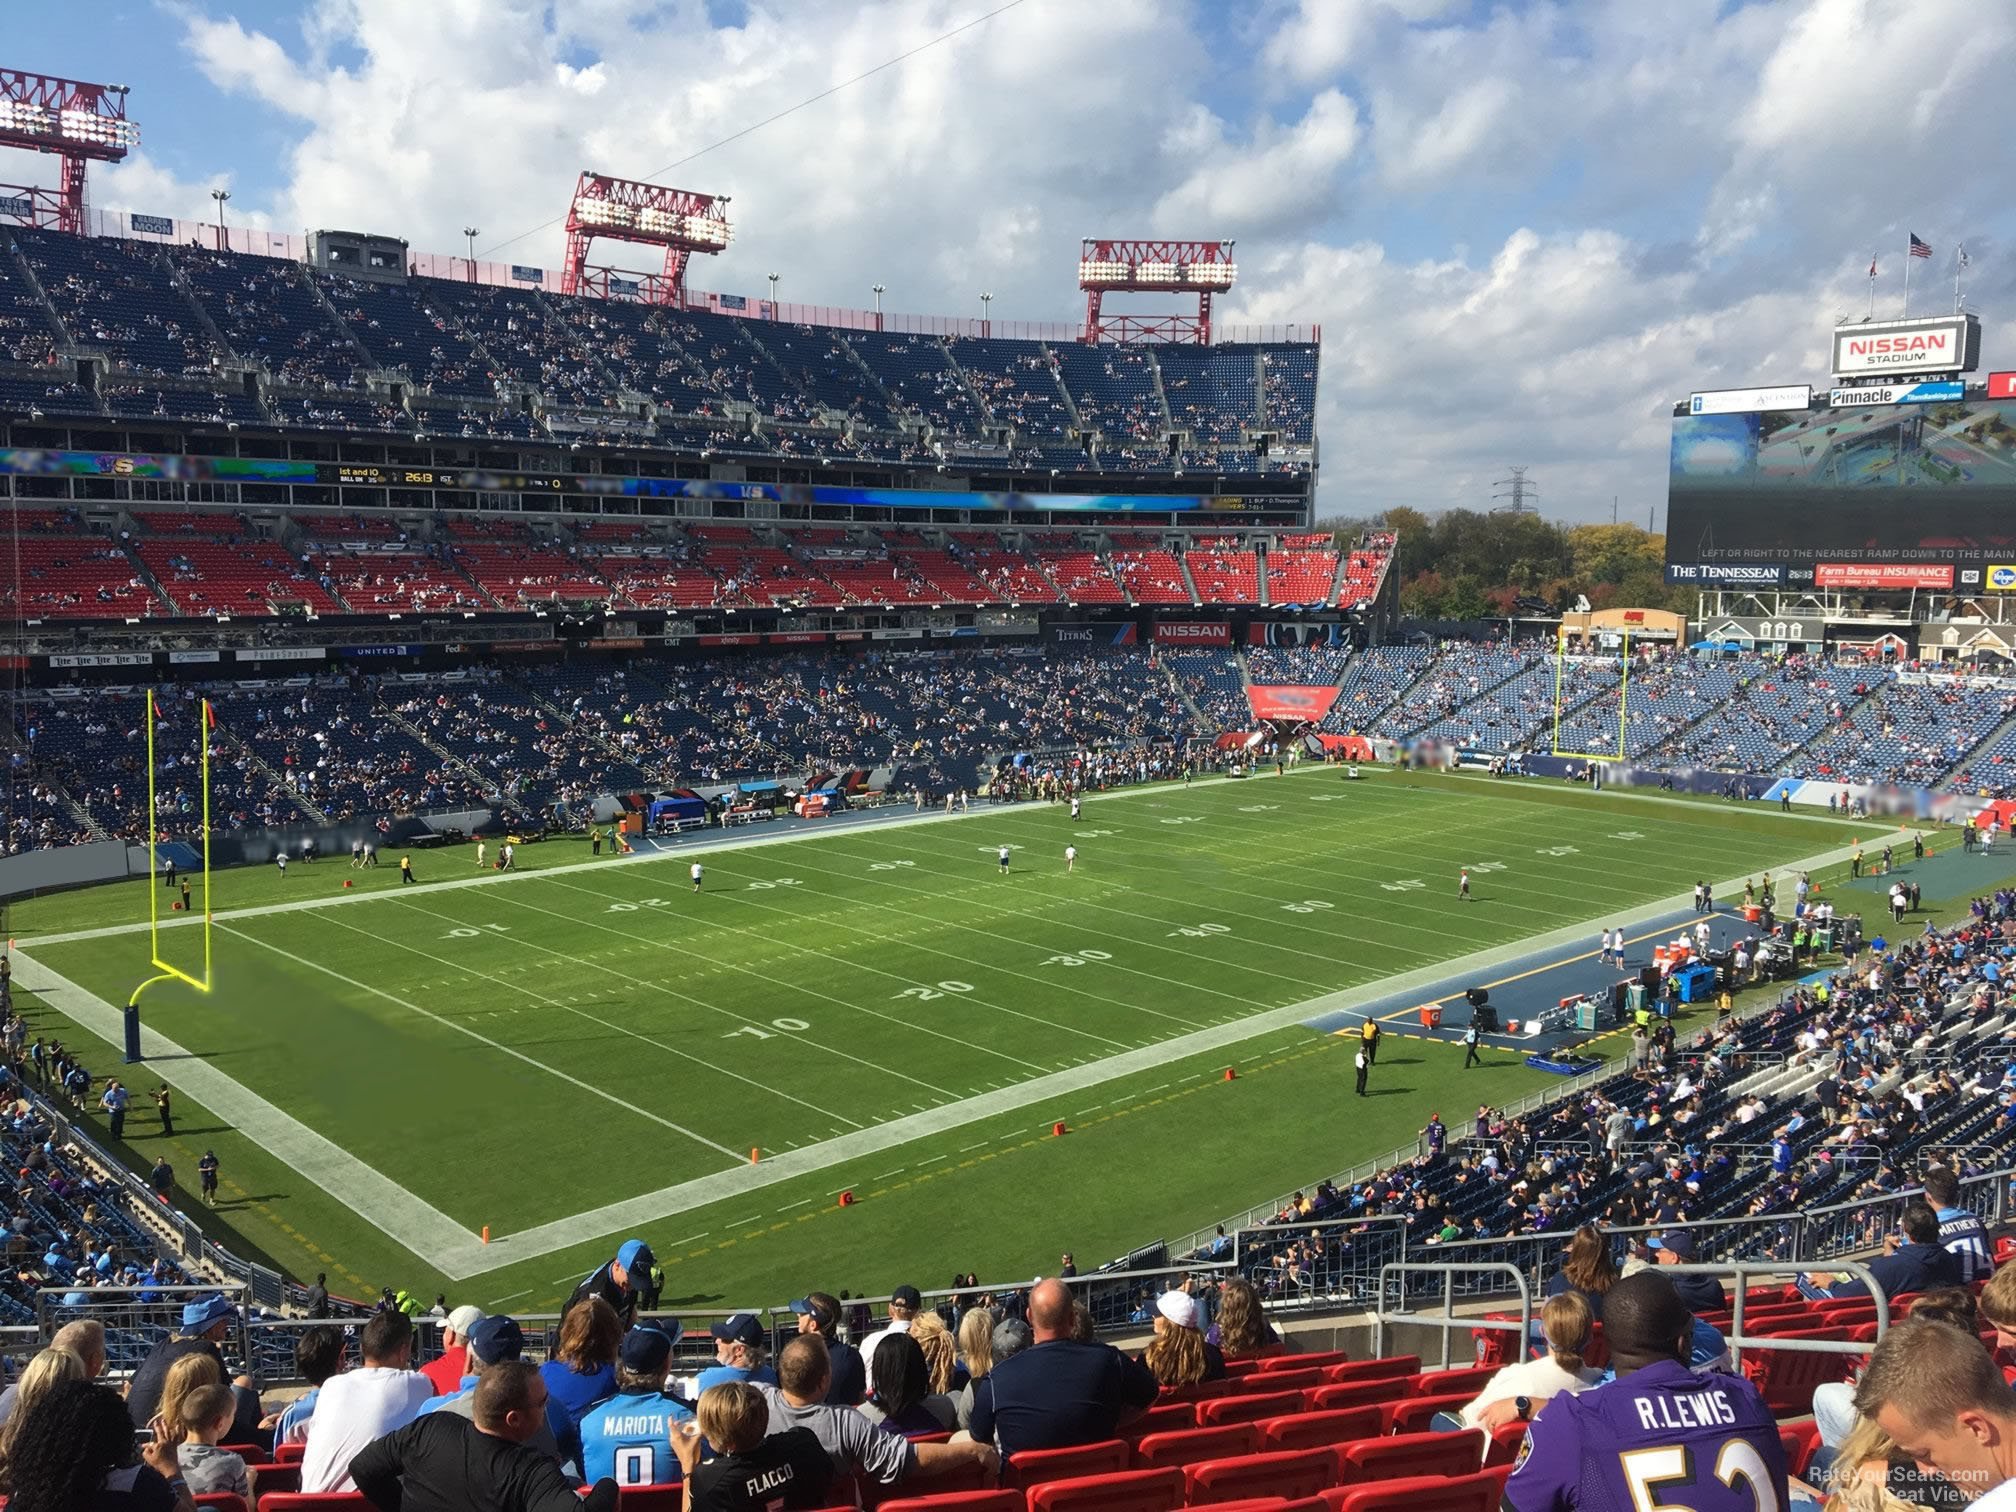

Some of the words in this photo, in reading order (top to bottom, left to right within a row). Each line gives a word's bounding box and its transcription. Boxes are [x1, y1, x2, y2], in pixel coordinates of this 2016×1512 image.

[134, 222, 171, 234] MOON
[1850, 334, 1946, 355] NISSAN
[1867, 352, 1926, 364] STADIUM
[1832, 388, 1892, 404] Pinnacle
[352, 468, 368, 476] and
[405, 472, 433, 483] 26:13
[552, 478, 561, 489] 0
[1702, 549, 1724, 557] LEFT
[1728, 549, 1741, 557] OR
[1744, 549, 1773, 558] RIGHT
[1777, 549, 1789, 558] TO
[1794, 549, 1812, 558] THE
[1815, 549, 1864, 558] NEAREST
[1867, 549, 1899, 558] RAMP
[1902, 549, 1936, 558] DOWN
[1941, 550, 1954, 559] TO
[1957, 550, 1980, 559] THE
[1984, 550, 2014, 559] MAIN
[1671, 565, 1697, 578] THE
[1700, 565, 1780, 578] TENNESSEAN
[1819, 566, 1844, 576] Farm
[1847, 567, 1881, 576] Bureau
[1884, 567, 1949, 577] INSURANCE
[1159, 625, 1226, 637] NISSAN
[664, 638, 681, 647] CMT
[720, 636, 740, 645] xfinity
[445, 644, 468, 653] FedEx
[56, 657, 71, 665] Lite
[75, 657, 91, 665] Lite
[96, 656, 111, 664] Lite
[115, 655, 130, 664] Lite
[135, 655, 150, 663] Lite
[1281, 900, 1335, 913] 50
[1179, 922, 1231, 937] 40
[1049, 948, 1112, 967] 30
[903, 980, 975, 1000] 20
[736, 1018, 810, 1039] 10
[1938, 1218, 1980, 1237] MATTHEWS
[344, 1324, 356, 1337] 55
[1633, 1390, 1736, 1430] R.LEWIS
[603, 1414, 664, 1436] MARIOTA
[746, 1462, 794, 1497] FLACCO
